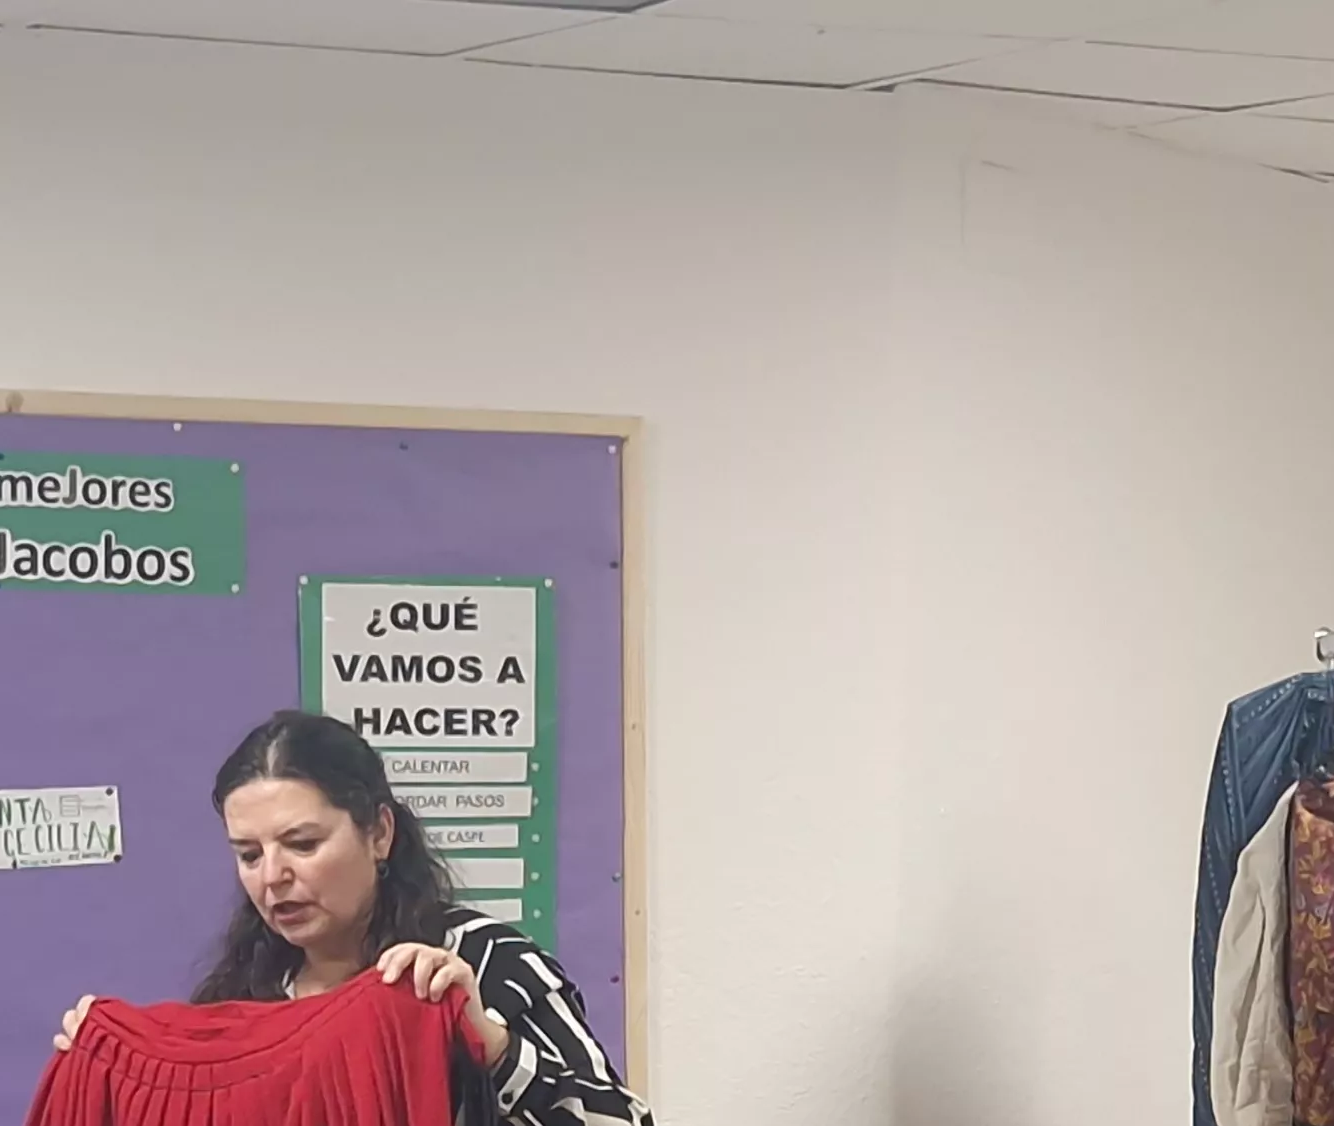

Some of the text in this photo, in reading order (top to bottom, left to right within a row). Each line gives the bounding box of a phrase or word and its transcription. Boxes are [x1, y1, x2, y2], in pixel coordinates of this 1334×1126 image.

[367, 597, 479, 636] ¿QUÉ
[332, 654, 526, 684] VAMOS A
[353, 707, 520, 737] HACER?
[391, 759, 470, 774] CALENTAR
[456, 794, 505, 808] PASOS
